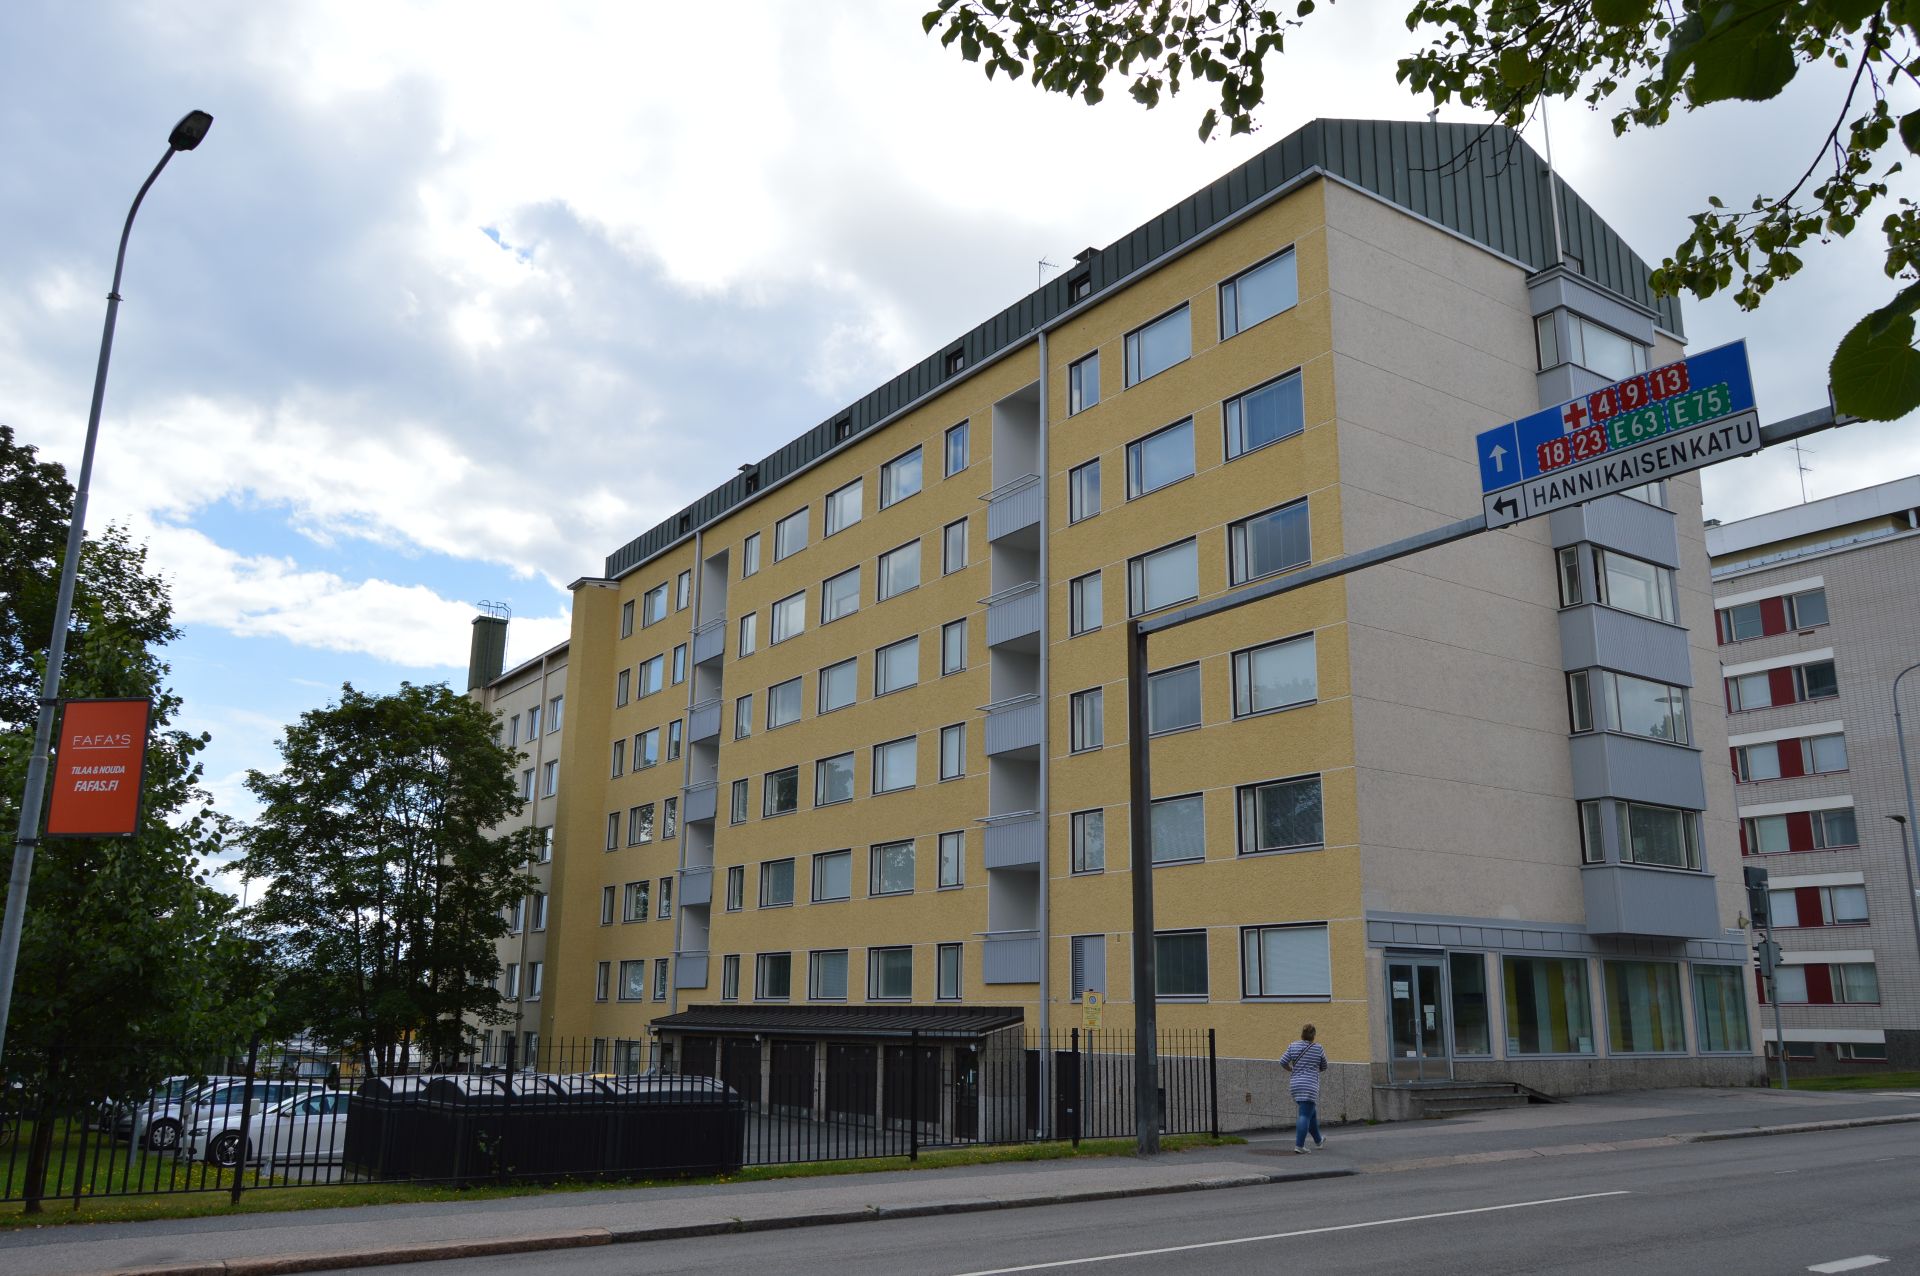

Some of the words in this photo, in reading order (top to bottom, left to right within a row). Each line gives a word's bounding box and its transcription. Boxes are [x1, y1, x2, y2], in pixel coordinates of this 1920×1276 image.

[1598, 395, 1610, 415] 4
[1626, 384, 1638, 404] 9
[1655, 369, 1681, 394] 13
[1543, 442, 1565, 466] 18
[1577, 431, 1603, 457] 23
[1533, 420, 1753, 508] HANNIKAISENKATU
[72, 734, 131, 746] FAFA'S
[71, 766, 92, 775] TILAA
[99, 765, 126, 774] NOUDA
[73, 780, 119, 792] FAFAS.FI
